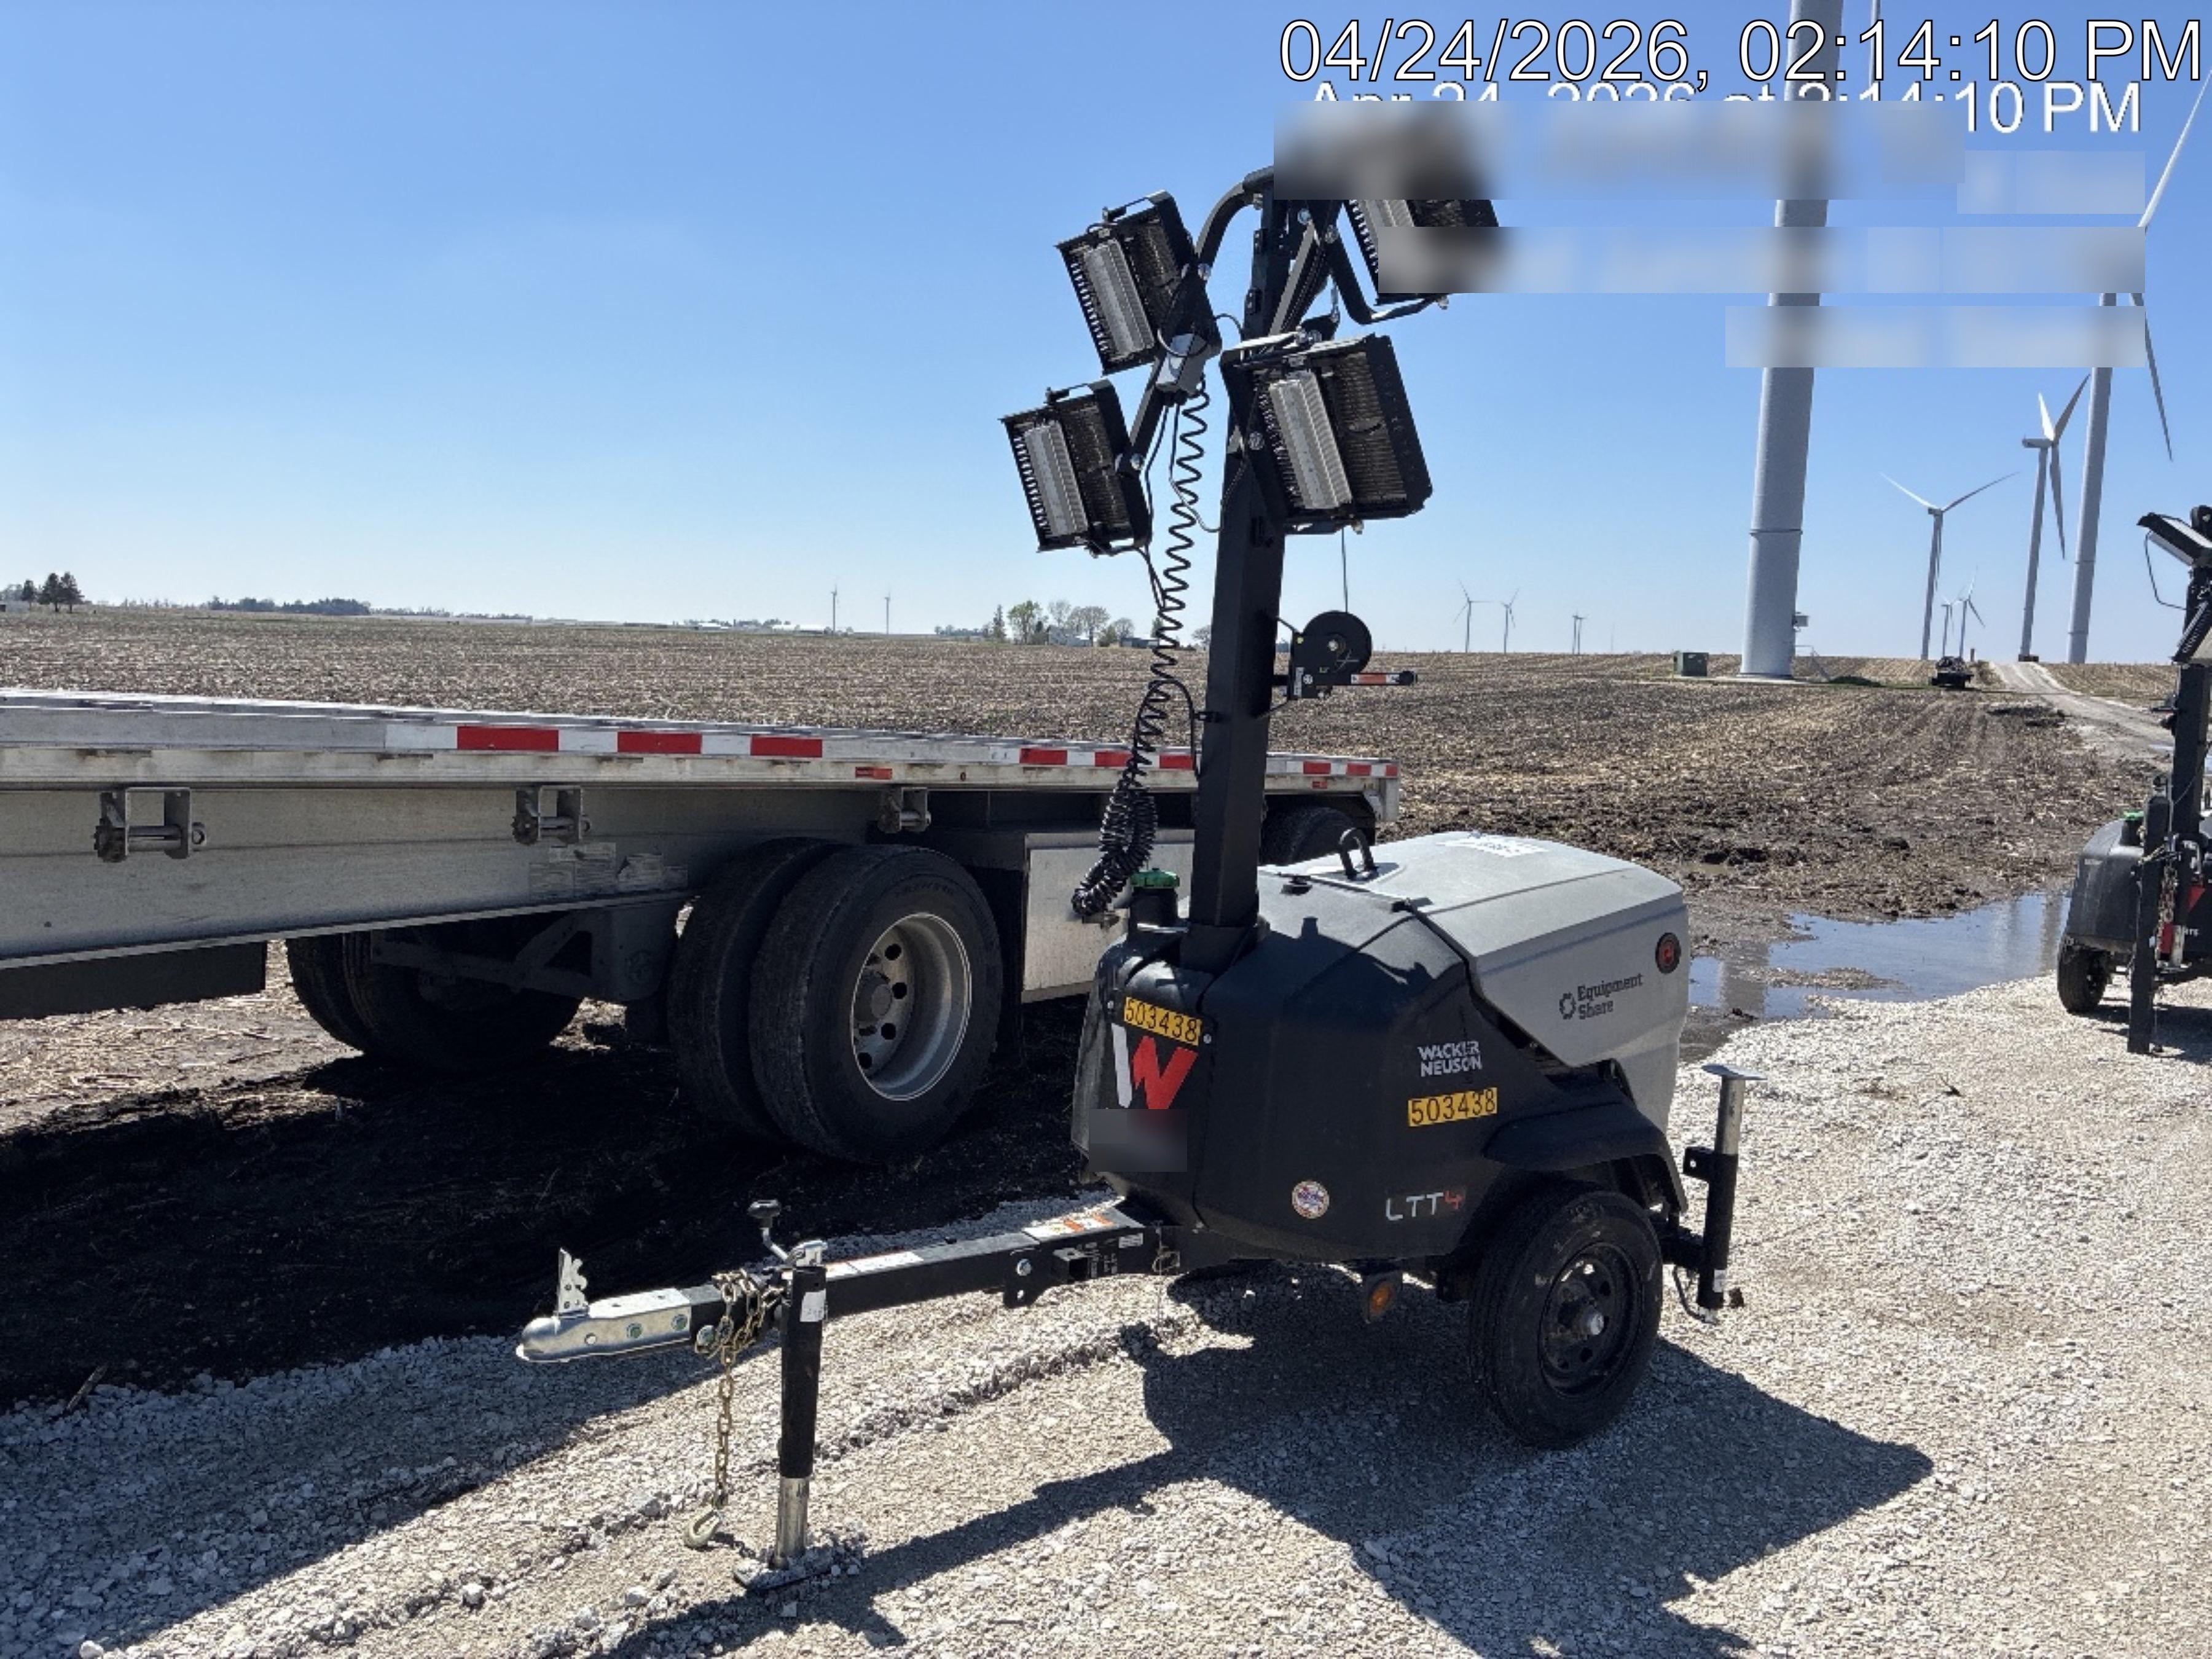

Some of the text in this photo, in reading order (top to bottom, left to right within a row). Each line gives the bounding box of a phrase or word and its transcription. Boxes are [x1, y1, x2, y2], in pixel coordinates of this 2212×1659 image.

[1577, 973, 1642, 1001] Equipment
[1126, 998, 1199, 1043] 503438
[1578, 1000, 1614, 1020] Share
[1417, 1040, 1480, 1061] WACKER
[1421, 1054, 1483, 1077] NEUSON
[1410, 1088, 1496, 1125] 503438
[1386, 1191, 1464, 1222] LTT4
